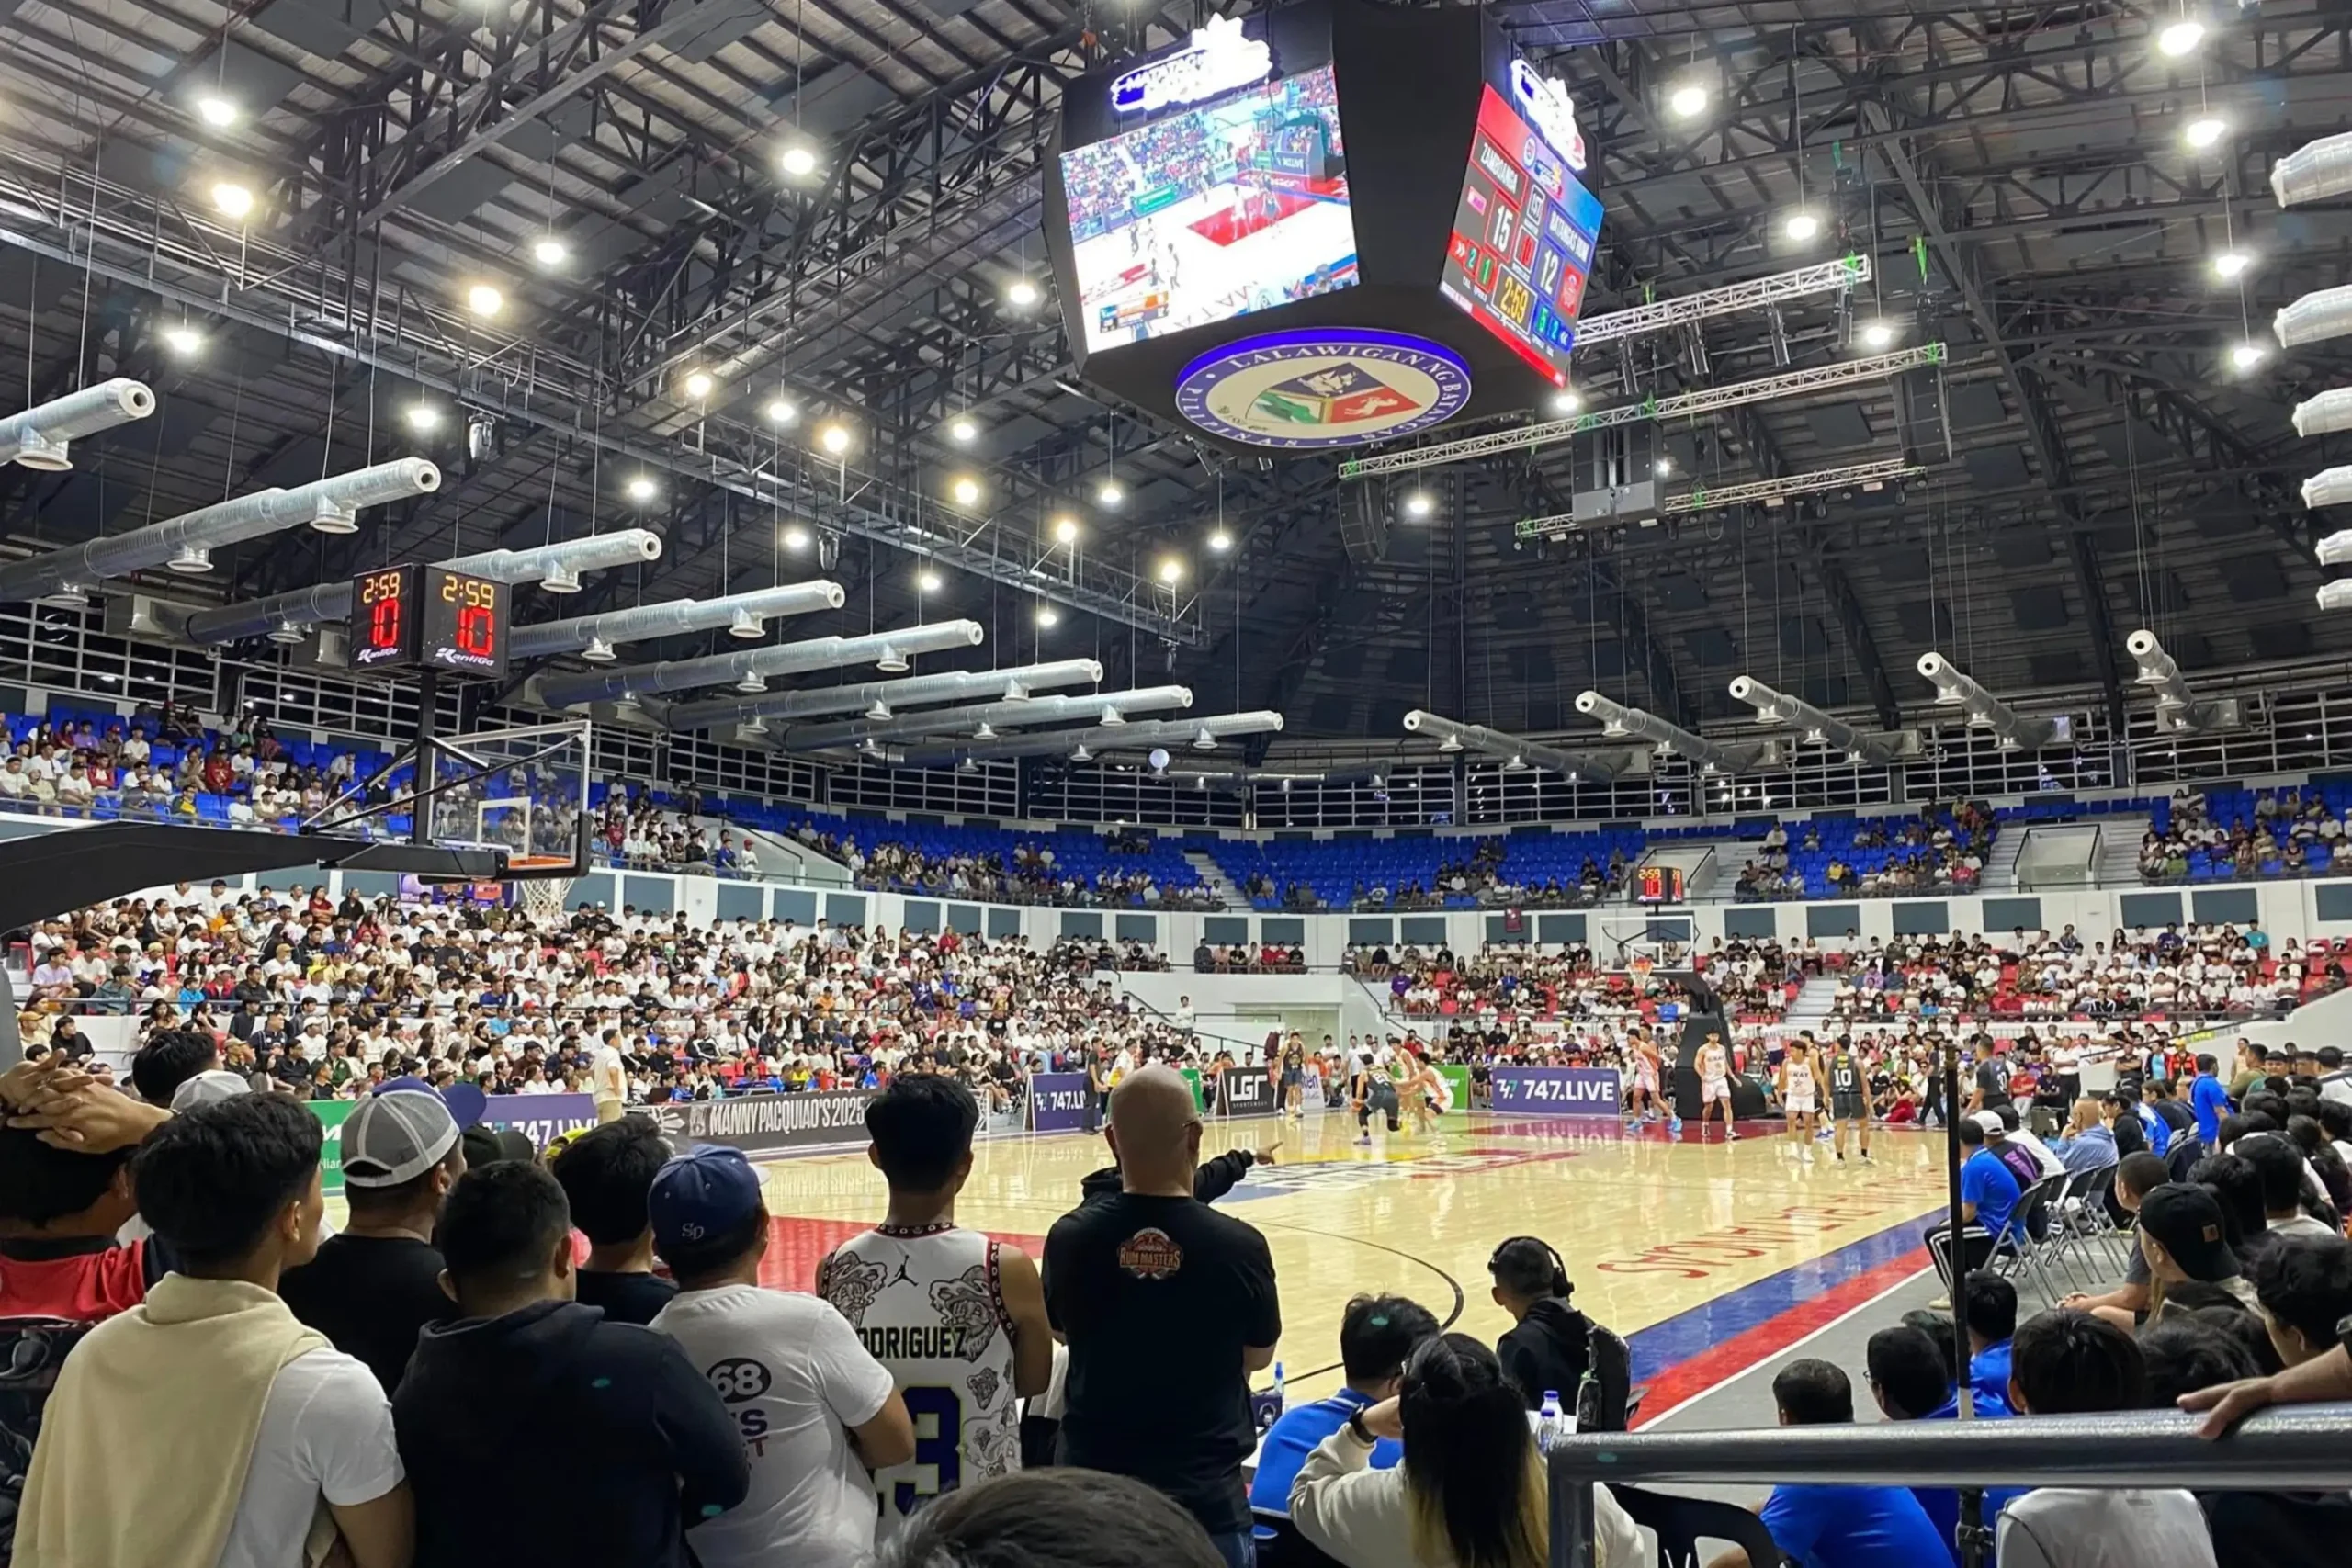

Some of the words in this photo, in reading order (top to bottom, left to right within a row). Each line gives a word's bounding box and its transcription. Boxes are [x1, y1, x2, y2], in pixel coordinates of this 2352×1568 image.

[1493, 205, 1513, 252] 15
[1467, 247, 1477, 269] 2
[1482, 258, 1491, 285] 1
[1540, 249, 1558, 295] 12
[1500, 276, 1529, 324] 2:59
[1537, 306, 1549, 333] 5
[1551, 320, 1560, 341] 2
[1229, 344, 1425, 368] LALAWIGAN
[1423, 362, 1455, 383] NG
[1181, 386, 1297, 447] PILIPINAS
[1361, 382, 1462, 440] BATANGAS
[364, 572, 400, 604] 2:59
[442, 575, 494, 610] 2:59
[372, 598, 400, 648] 10
[457, 606, 494, 657] 10
[1638, 868, 1661, 880] 2:59
[1645, 879, 1661, 897] 10
[1523, 1079, 1614, 1101] 747.LIVE
[1834, 1069, 1852, 1087] 10
[710, 1103, 759, 1137] MANNY
[759, 1097, 831, 1135] PACQUIAO'S
[831, 1096, 865, 1128] 2025
[1120, 1247, 1139, 1266] RUM
[1139, 1250, 1181, 1269] MASTERS
[855, 1326, 967, 1359] ODRIGUEZ
[710, 1362, 763, 1400] 68
